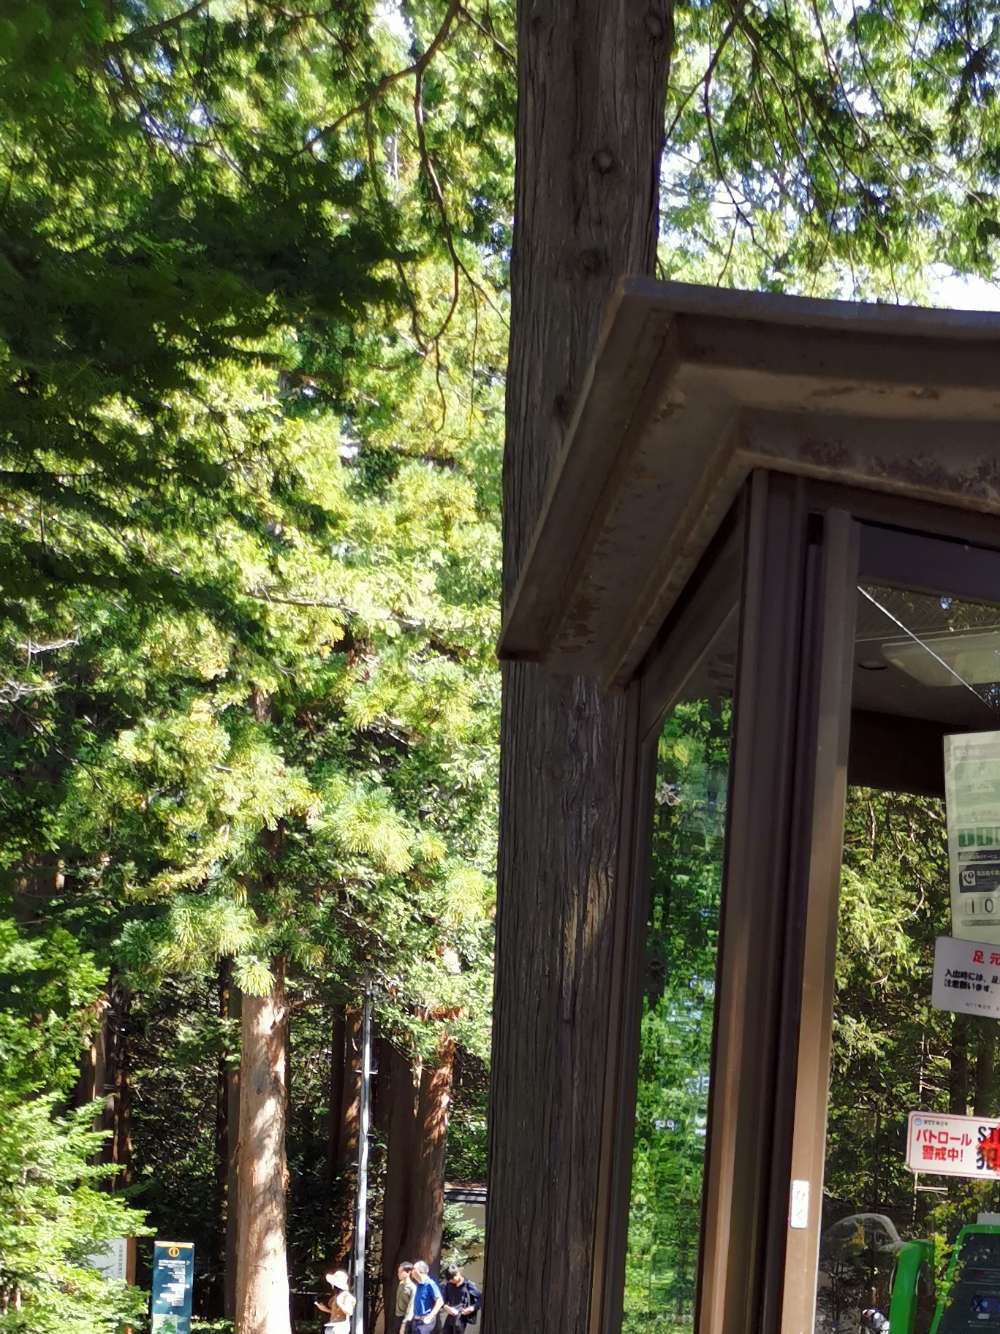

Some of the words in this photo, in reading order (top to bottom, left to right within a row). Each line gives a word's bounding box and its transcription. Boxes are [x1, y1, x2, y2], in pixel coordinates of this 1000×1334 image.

[916, 1129, 972, 1147] パトロール
